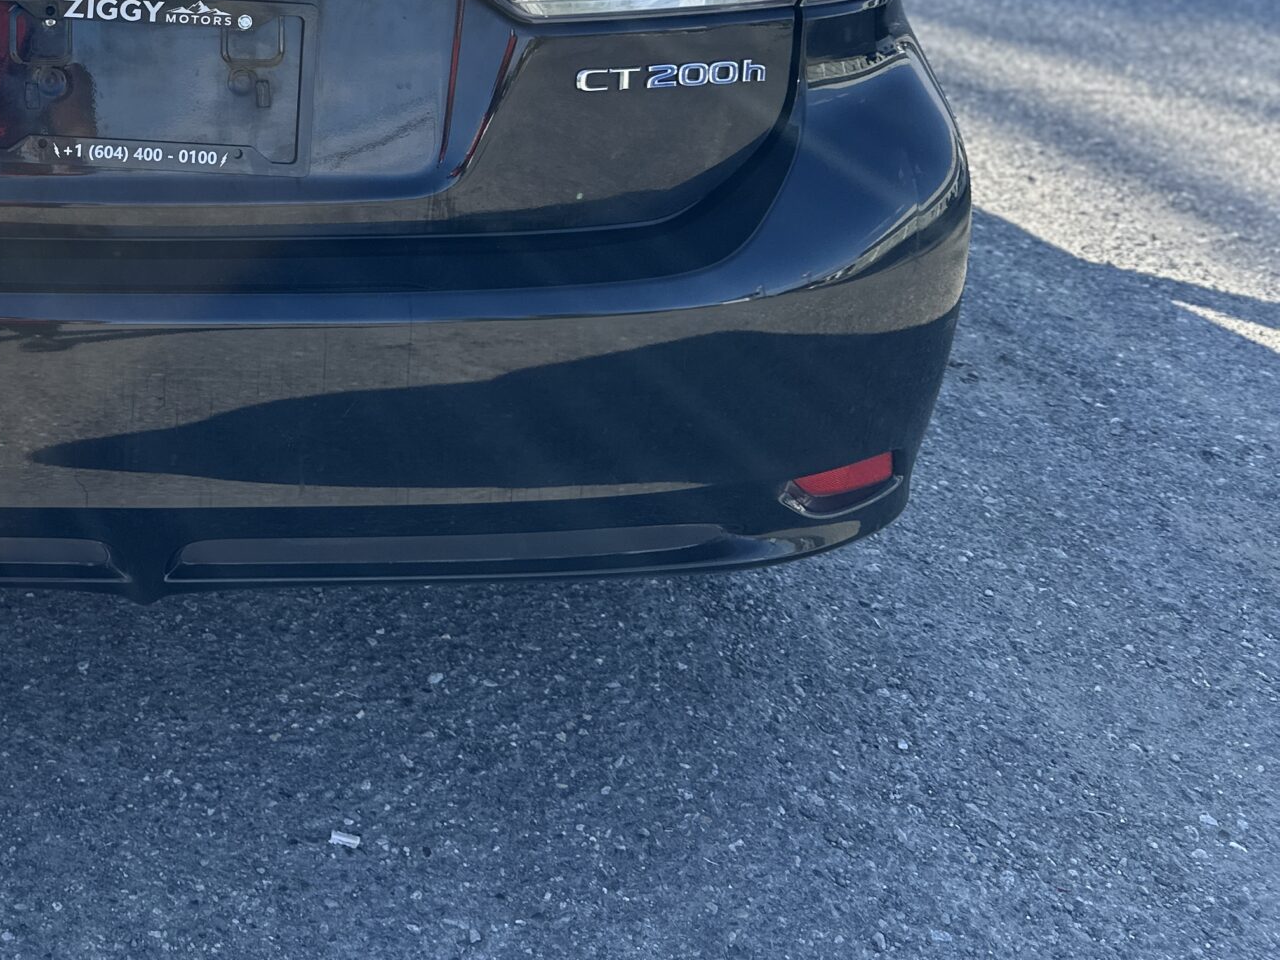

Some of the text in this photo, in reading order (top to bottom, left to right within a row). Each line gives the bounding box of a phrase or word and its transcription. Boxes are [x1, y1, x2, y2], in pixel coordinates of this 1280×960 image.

[166, 13, 232, 26] MOTORS
[63, 143, 82, 158] +1
[88, 145, 129, 162] (604)
[133, 148, 163, 162] 400
[178, 149, 217, 165] 0100
